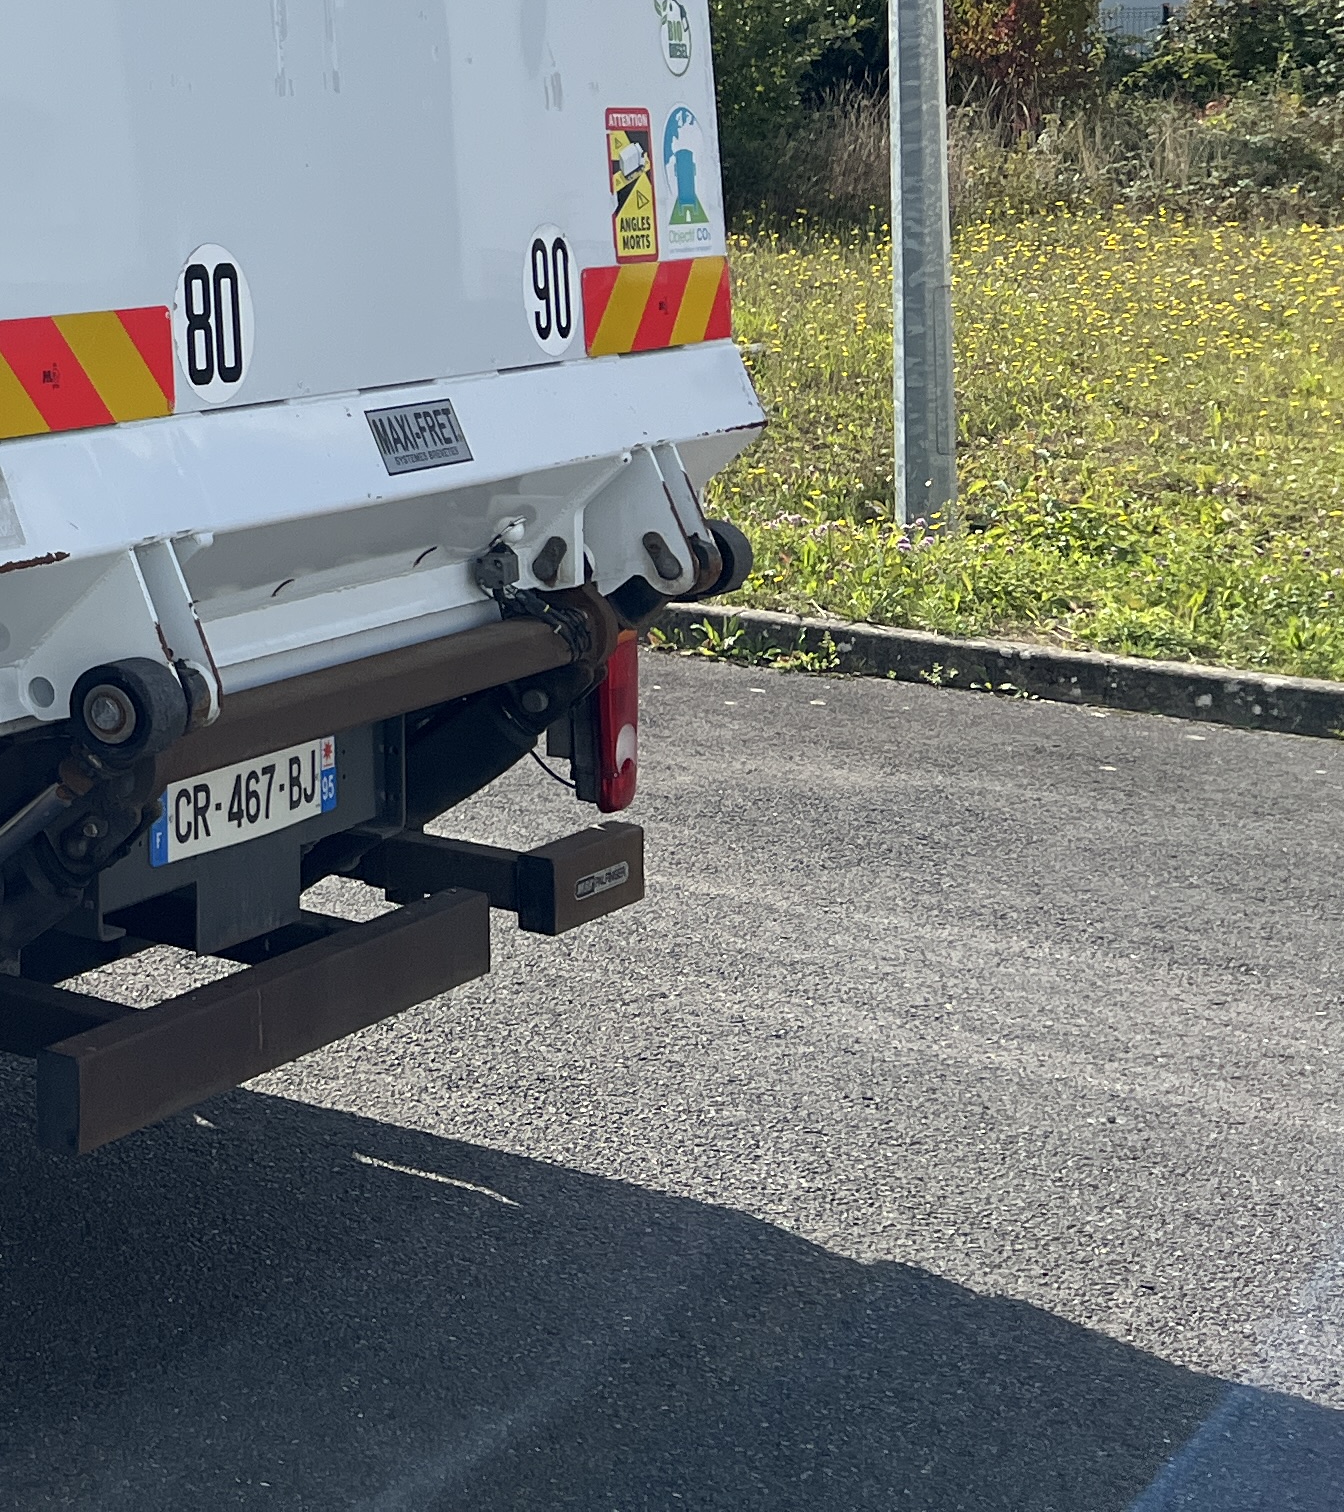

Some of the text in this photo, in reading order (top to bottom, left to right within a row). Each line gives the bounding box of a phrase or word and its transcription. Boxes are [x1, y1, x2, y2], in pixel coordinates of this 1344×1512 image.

[620, 216, 651, 232] ANGLES
[622, 234, 651, 250] MORTS
[531, 237, 571, 340] 90
[184, 262, 243, 386] 80
[372, 408, 459, 455] MAXI-FRET
[175, 749, 316, 844] CR-467-BJ
[321, 774, 334, 801] 95
[155, 831, 163, 849] F
